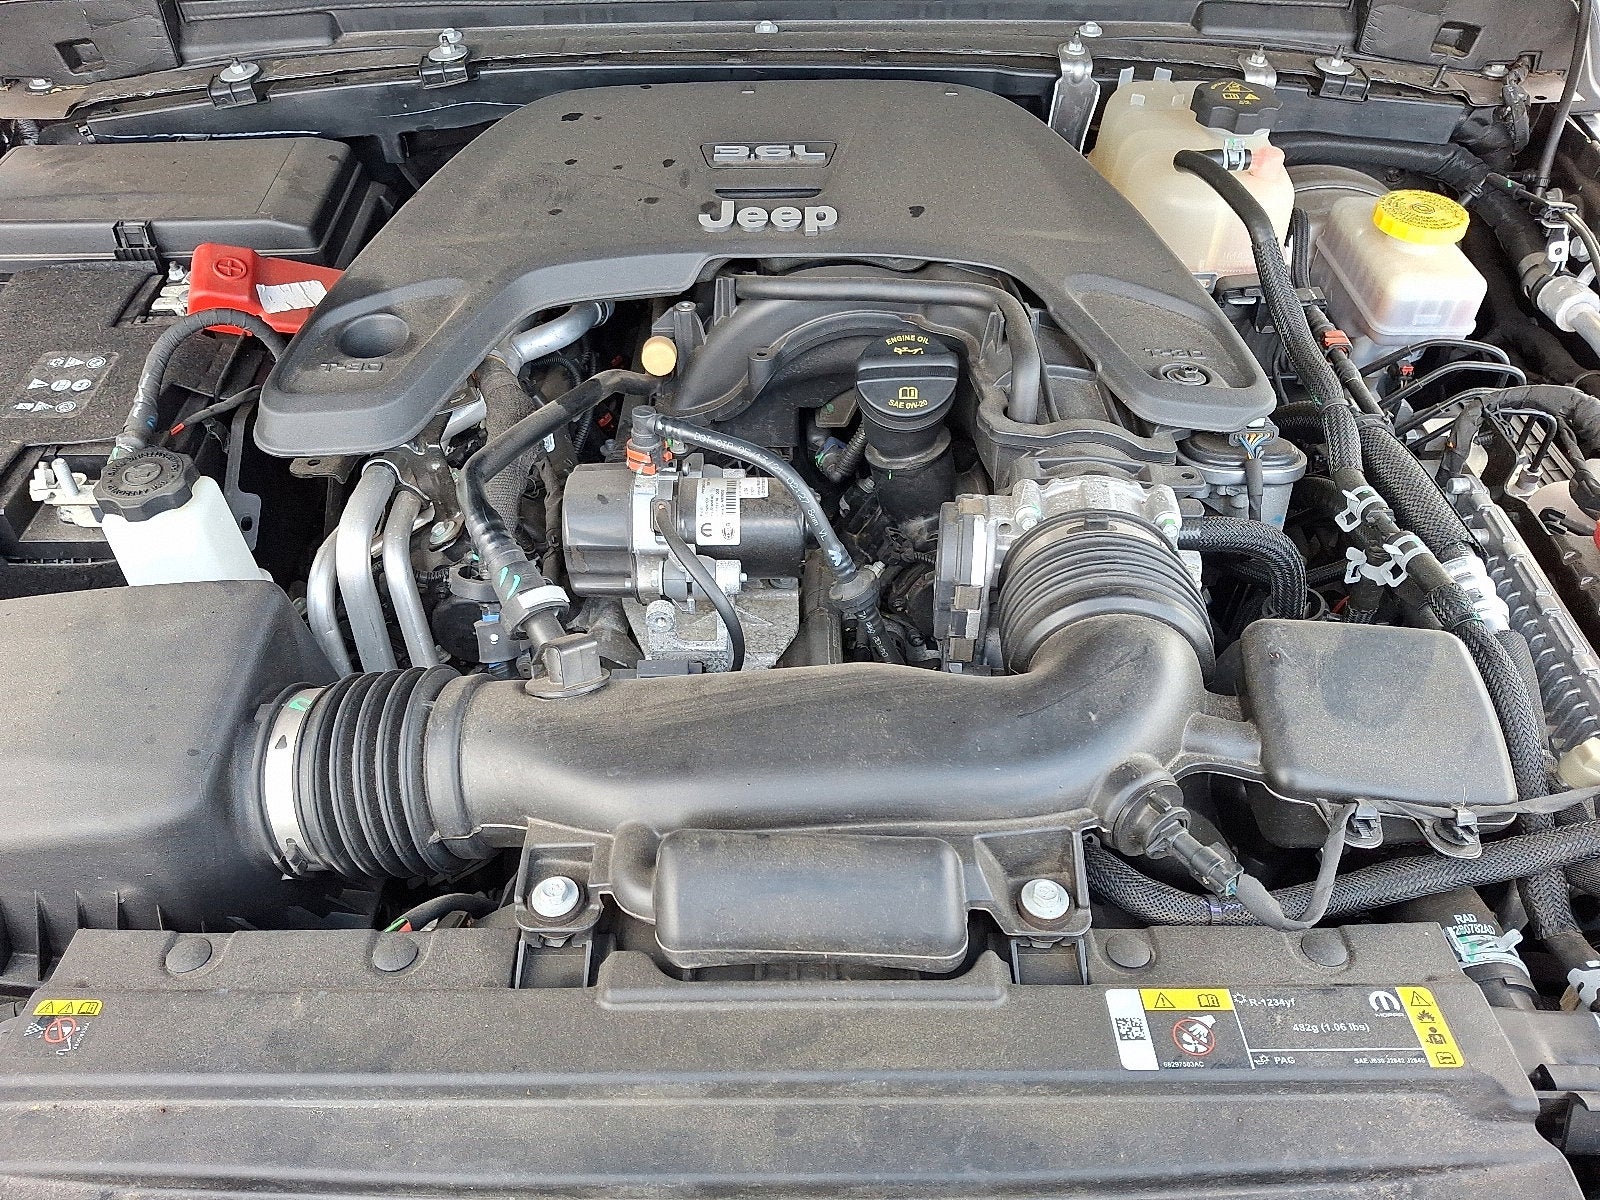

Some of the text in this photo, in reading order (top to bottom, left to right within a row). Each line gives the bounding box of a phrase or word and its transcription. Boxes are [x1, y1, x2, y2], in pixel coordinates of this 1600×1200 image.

[713, 144, 826, 161] 3.6L
[698, 200, 838, 237] Jeep
[885, 334, 930, 346] ENGINE OIL
[888, 399, 905, 409] SAE
[1453, 913, 1478, 925] RAD
[1249, 997, 1296, 1008] R-1234yf
[1348, 1022, 1370, 1034] lbs)
[1273, 1056, 1296, 1065] PAG
